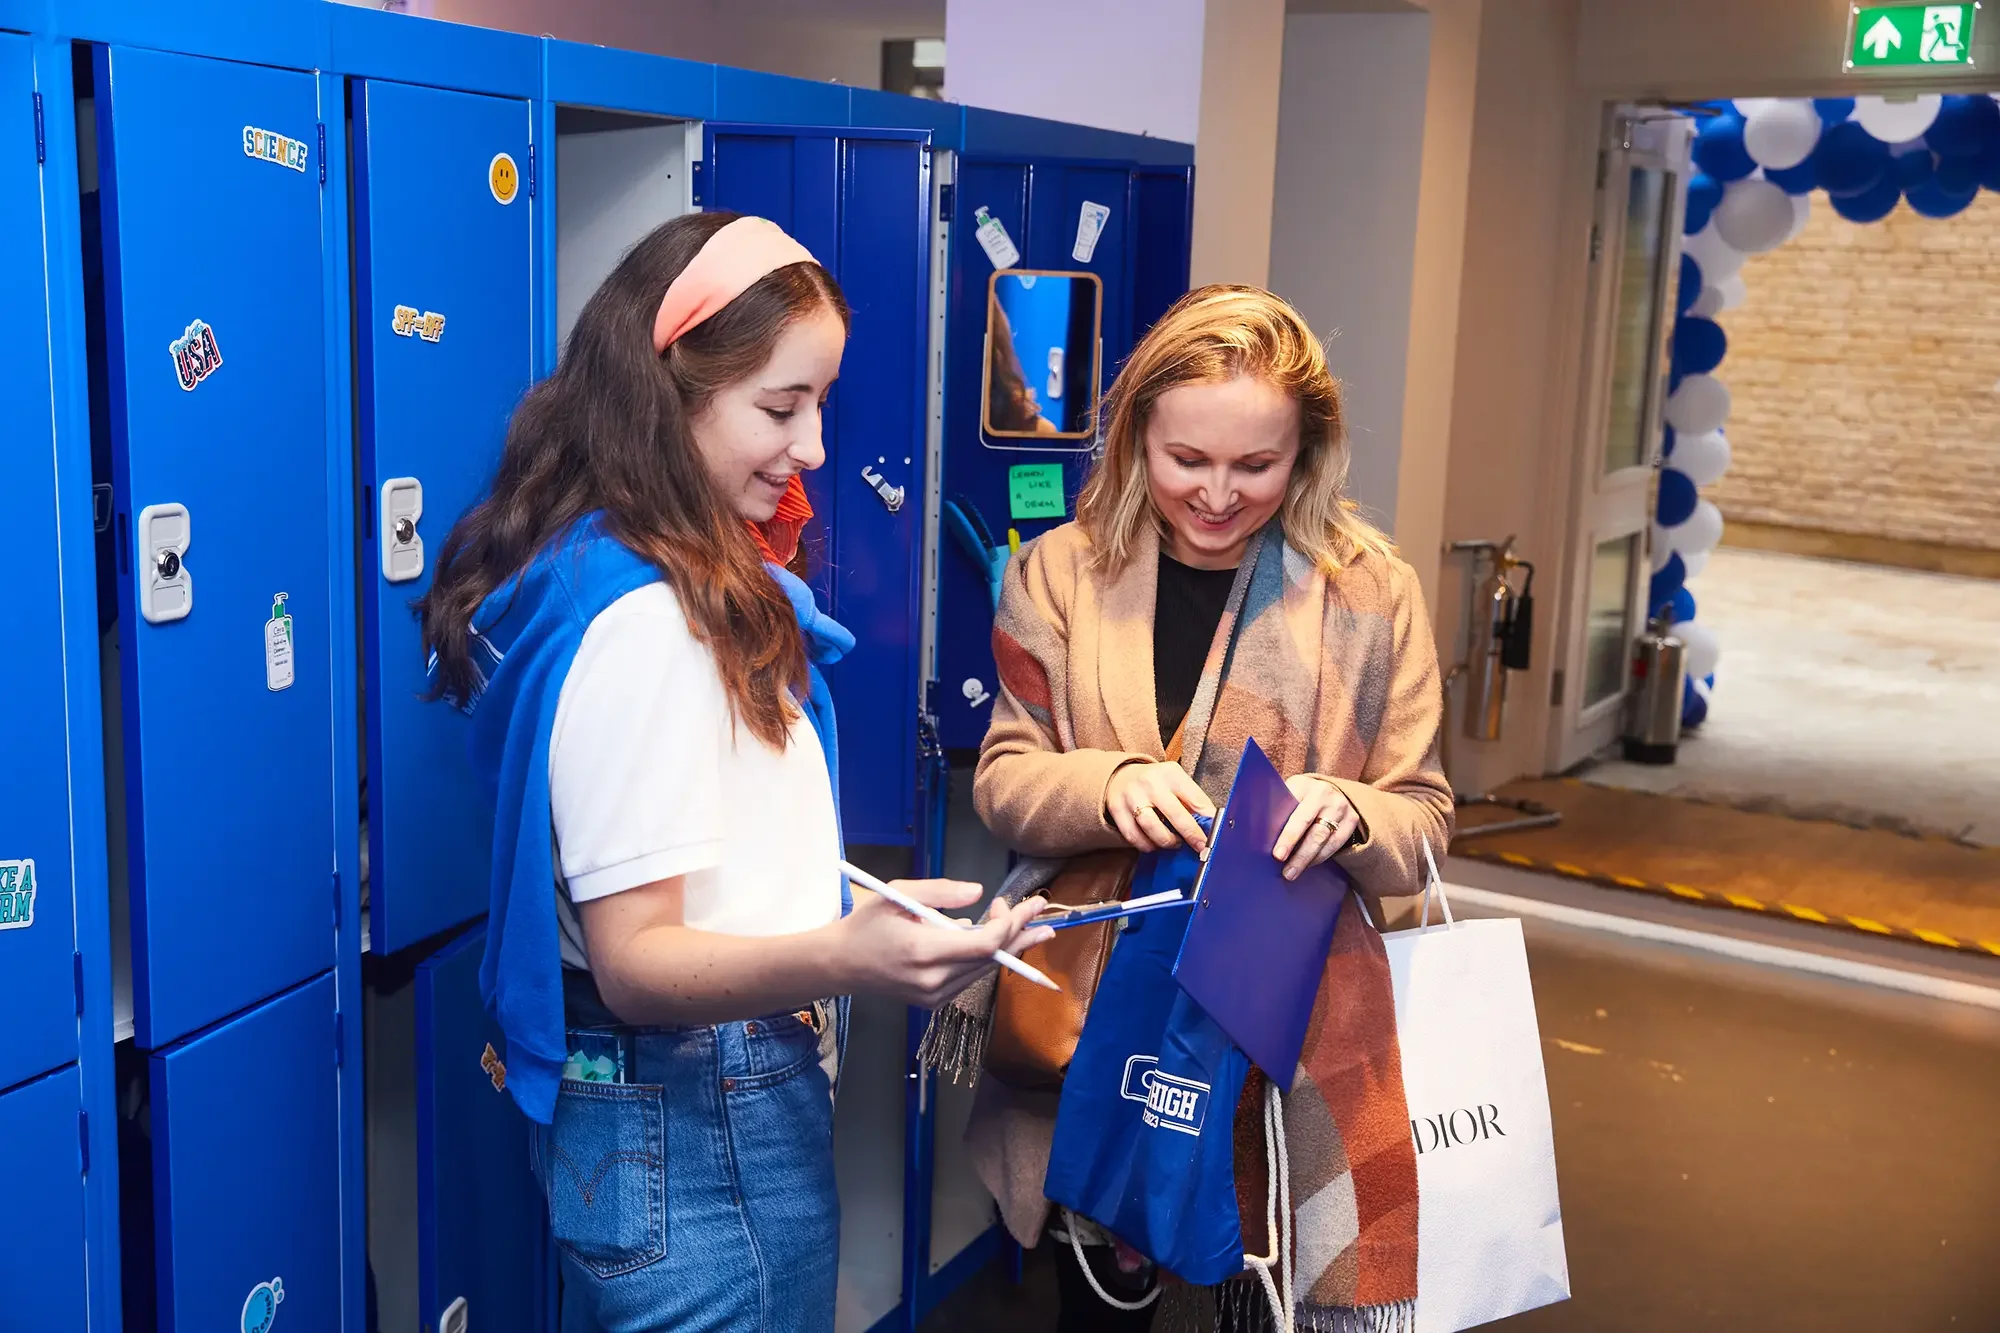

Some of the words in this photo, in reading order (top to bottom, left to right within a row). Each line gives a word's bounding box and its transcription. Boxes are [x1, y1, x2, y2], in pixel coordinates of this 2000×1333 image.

[246, 129, 306, 169] SCIENCE
[176, 327, 221, 388] USA
[1028, 480, 1052, 489] LIKE
[19, 864, 33, 892] A
[1148, 1079, 1199, 1122] HIGH
[1411, 1103, 1507, 1155] DIOR
